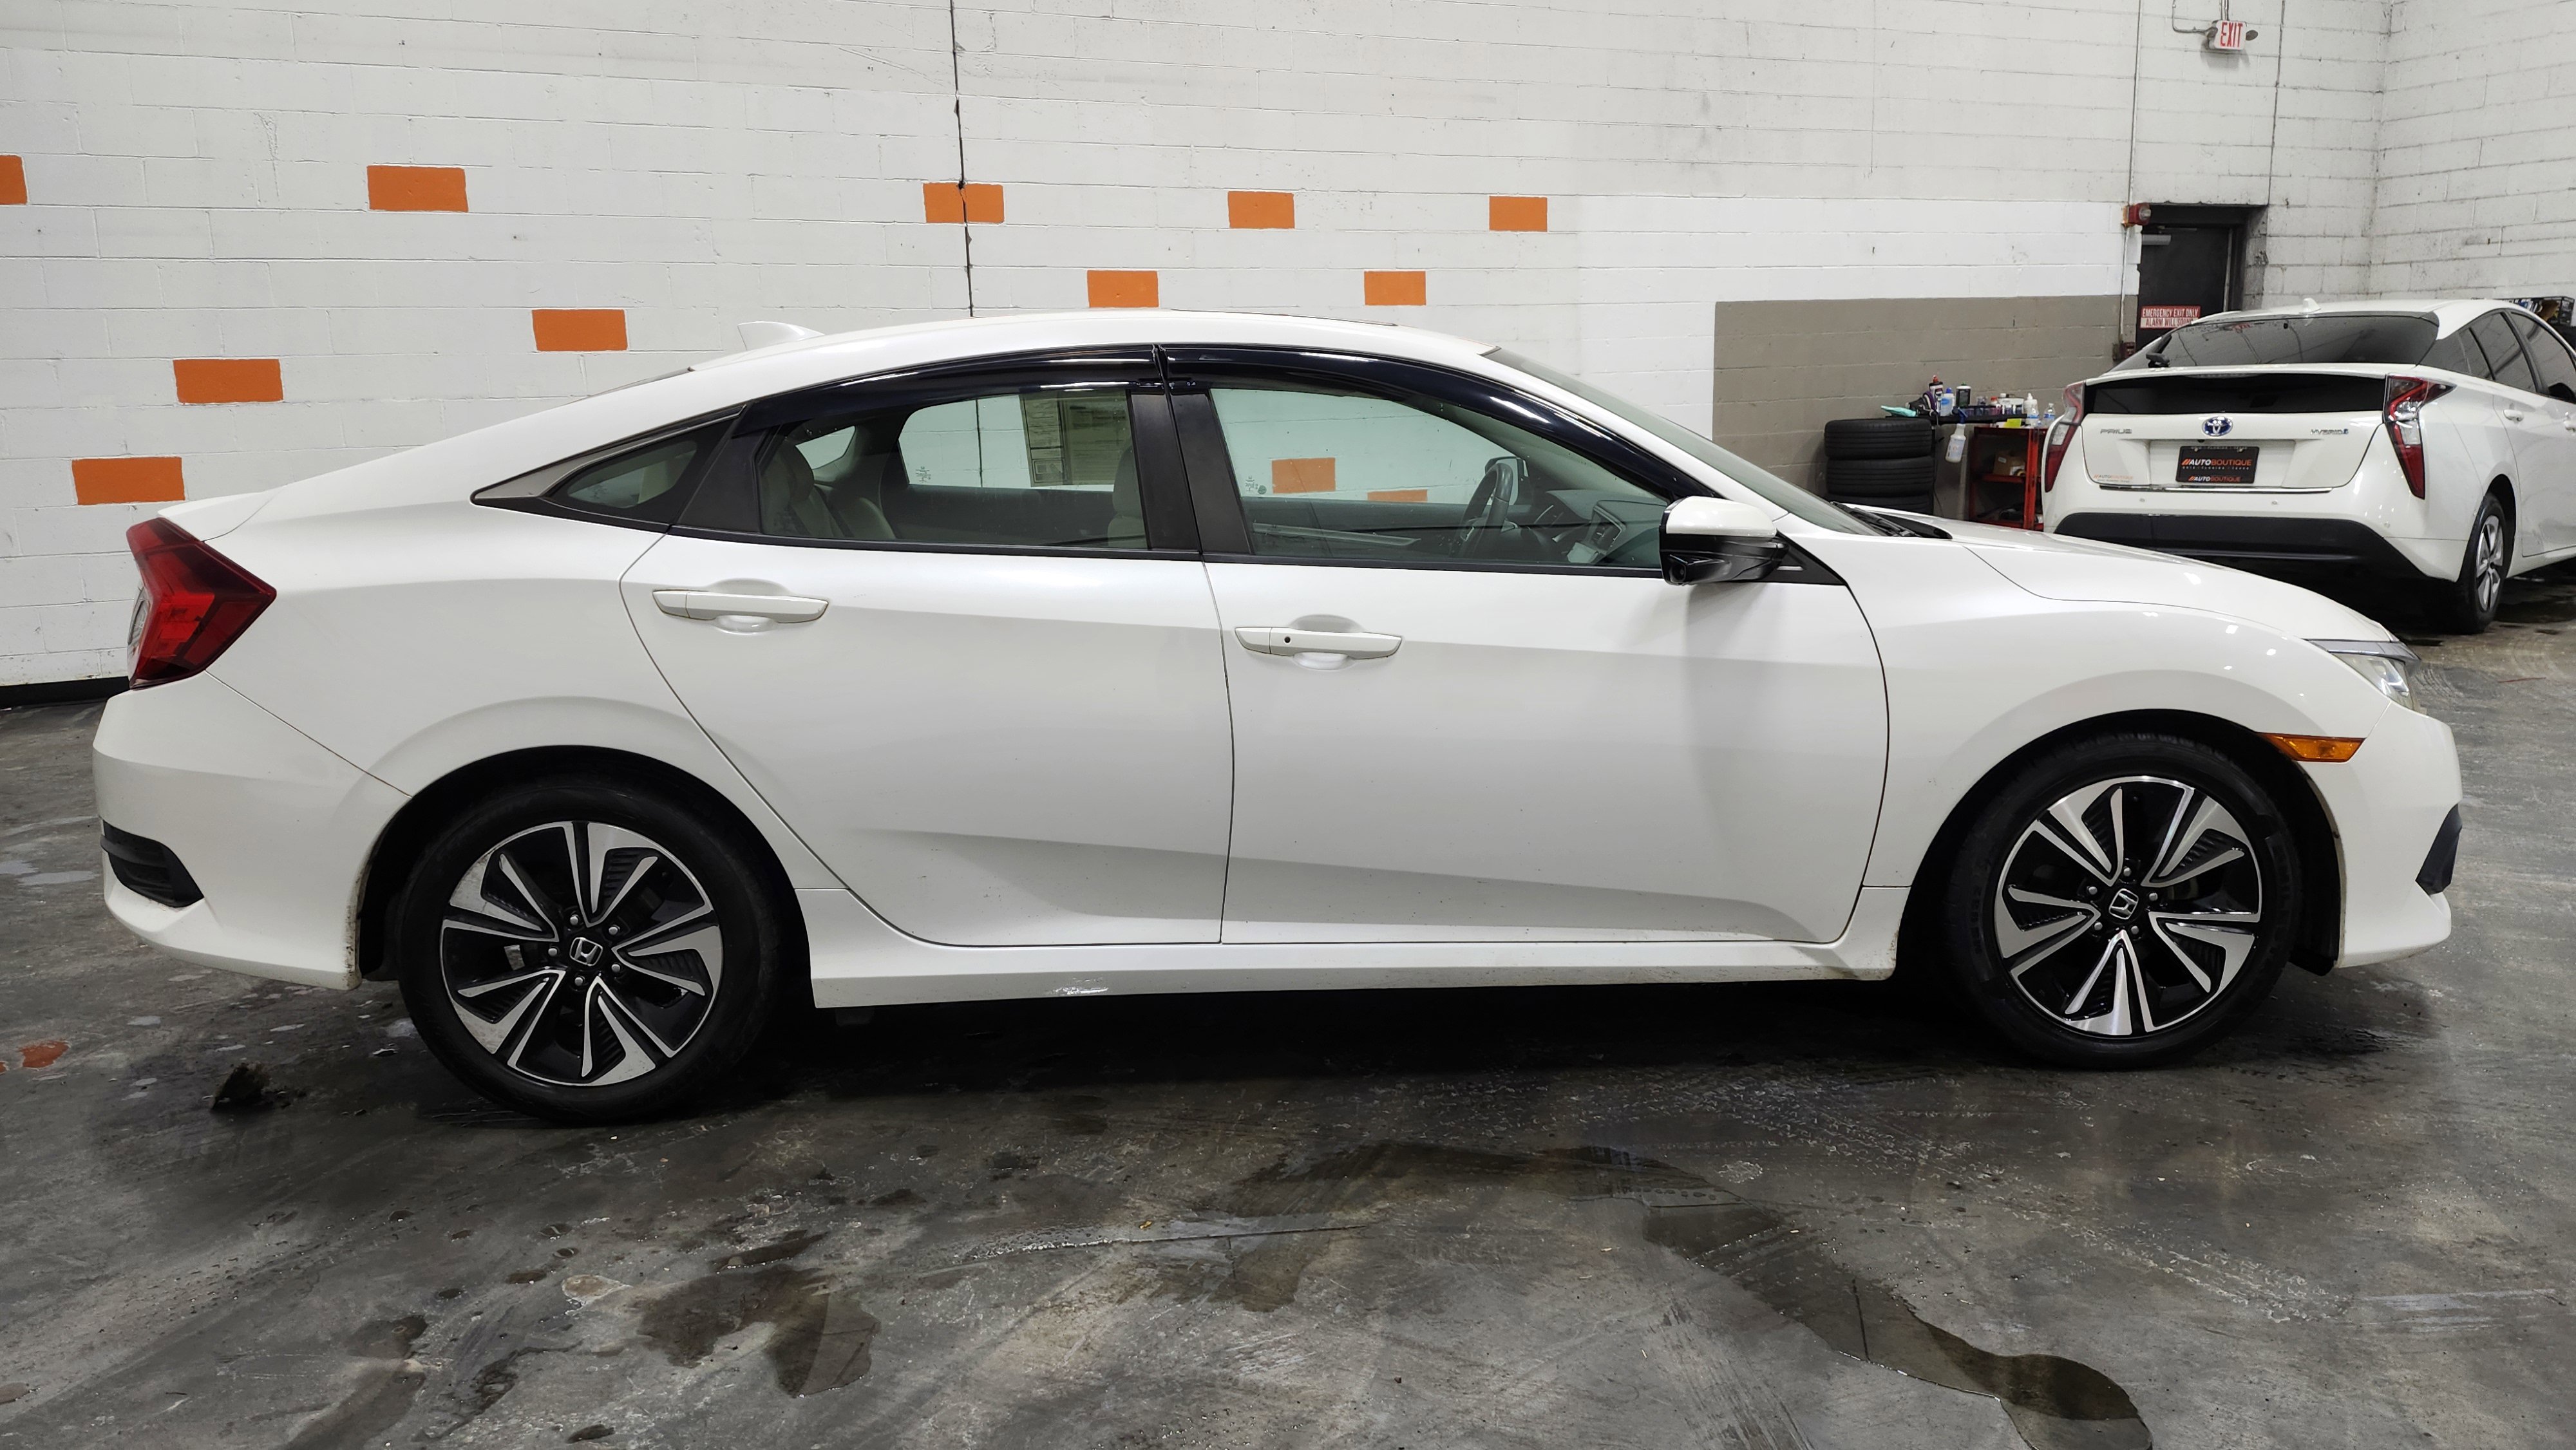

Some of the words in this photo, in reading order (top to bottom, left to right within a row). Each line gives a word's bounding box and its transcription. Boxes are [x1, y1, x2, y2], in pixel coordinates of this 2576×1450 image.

[2220, 22, 2243, 48] EXIT
[2143, 308, 2172, 317] EMERGENCY
[2174, 308, 2185, 317] EXIT
[2186, 308, 2199, 317] ONLY
[2146, 317, 2163, 327] ALARM
